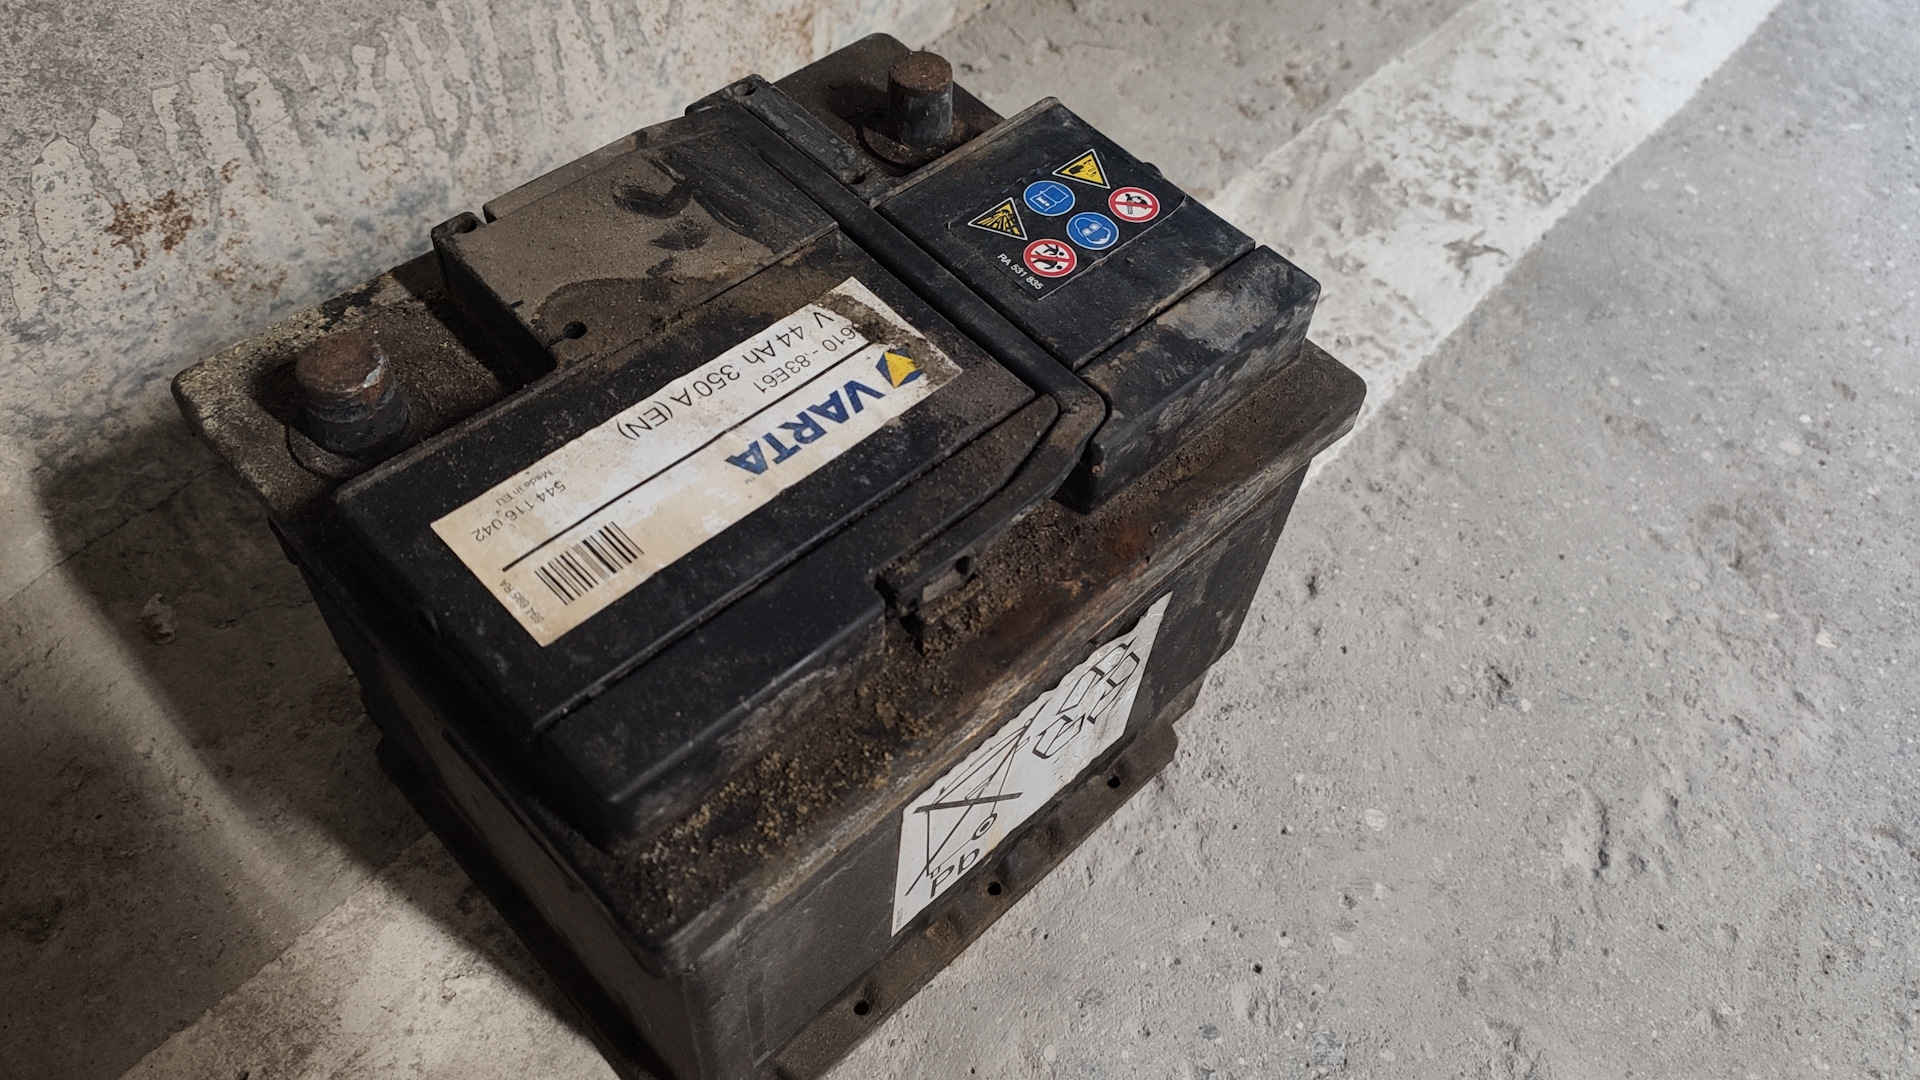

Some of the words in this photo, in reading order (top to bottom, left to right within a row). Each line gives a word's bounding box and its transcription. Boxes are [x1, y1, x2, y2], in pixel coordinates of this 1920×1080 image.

[997, 253, 1012, 266] RA
[1010, 264, 1028, 278] 531
[1025, 276, 1045, 290] 835
[813, 312, 835, 328] V
[775, 325, 804, 347] 44
[742, 340, 776, 364] Ah
[693, 364, 740, 397] 350
[752, 354, 811, 394] 83E61
[670, 387, 693, 407] A
[617, 400, 673, 440] (EN)
[724, 380, 886, 475] VARTA
[523, 468, 554, 488] Made
[495, 493, 513, 507] EU
[513, 487, 525, 496] in
[536, 480, 566, 503] 544
[504, 499, 535, 521] 116
[930, 848, 980, 899] Pb
